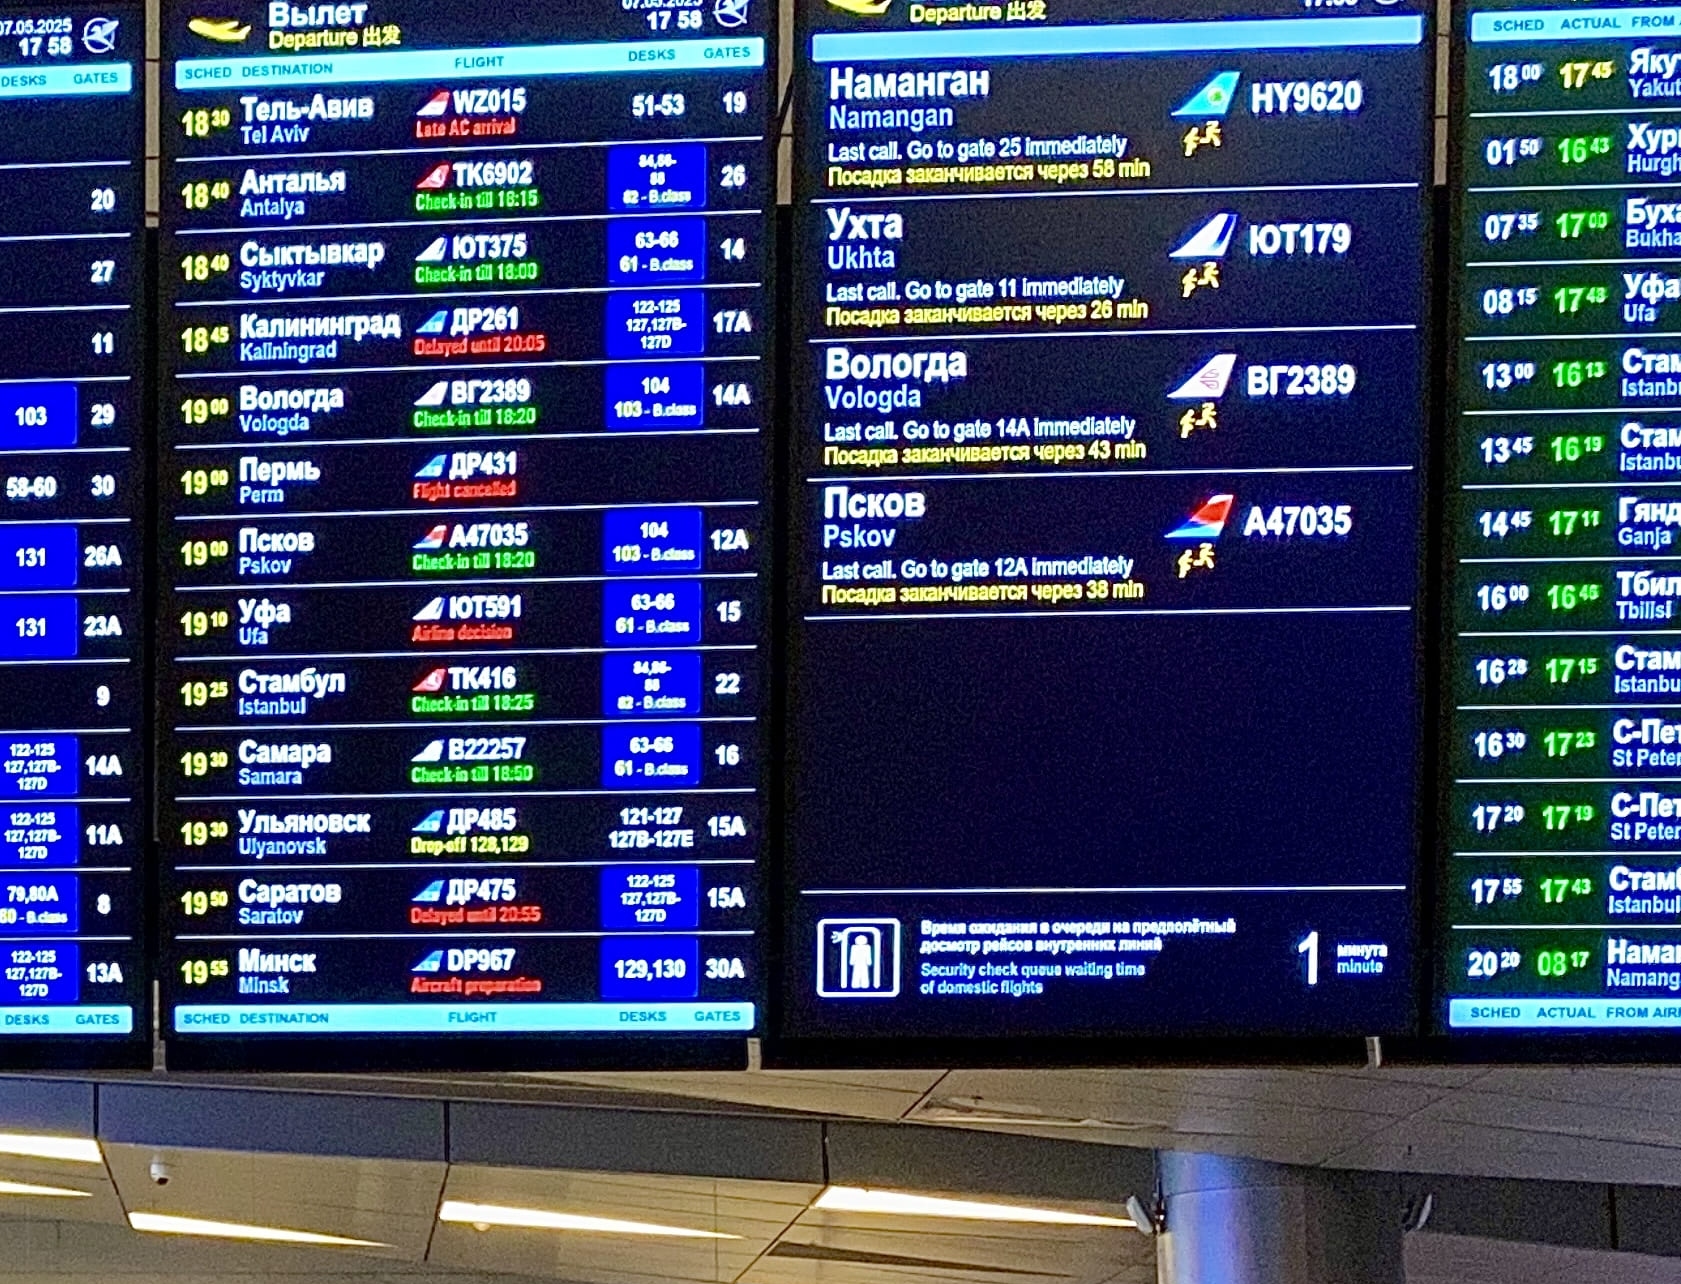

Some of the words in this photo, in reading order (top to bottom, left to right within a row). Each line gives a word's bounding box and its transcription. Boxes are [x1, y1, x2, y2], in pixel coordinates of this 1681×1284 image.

[269, 3, 367, 28] Вылет
[1494, 20, 1544, 32] SCHED
[1561, 18, 1620, 29] ACTUAL
[1632, 16, 1674, 28] FROM
[269, 29, 358, 49] Departure
[829, 69, 989, 100] Наманган
[241, 94, 374, 121] Тель-Авив
[454, 89, 526, 113] WZ015
[632, 95, 684, 116] 51-53
[723, 92, 746, 113] 19
[1251, 81, 1362, 112] HY9620
[829, 106, 953, 131] Namangan
[241, 126, 266, 144] Tel
[270, 125, 309, 143] Aviv
[828, 142, 865, 162] Last
[869, 140, 902, 160] call.
[907, 140, 932, 159] Go
[936, 139, 953, 158] to
[957, 140, 994, 161] gate
[999, 138, 1020, 157] 25
[1025, 135, 1126, 158] immediately
[828, 165, 902, 187] Посадка
[906, 162, 1033, 184] заканчивается
[1038, 160, 1087, 181] через
[1092, 160, 1114, 178] 58
[1118, 159, 1150, 177] min
[827, 209, 903, 240] Ухта
[452, 235, 527, 259] ЮТ375
[722, 239, 744, 259] 14
[1249, 224, 1351, 255] ЮТ179
[241, 241, 384, 269] Сыктывкар
[241, 270, 325, 290] Syktyvkar
[1623, 273, 1679, 299] Уфа
[1623, 304, 1655, 322] Ufa
[241, 313, 401, 340] Калининград
[92, 333, 114, 353] 11
[241, 341, 336, 361] Kaliningrad
[241, 386, 344, 412] Вологда
[452, 381, 530, 405] ВГ2389
[15, 408, 47, 425] 103
[92, 406, 114, 424] 29
[240, 458, 320, 485] Пермь
[240, 486, 284, 504] Perm
[823, 488, 925, 518] Псков
[823, 525, 894, 549] Pskov
[1619, 529, 1671, 546] Ganja
[1617, 602, 1672, 619] Tbilisi
[239, 741, 331, 765] Самара
[239, 767, 302, 785] Samara
[239, 810, 370, 834] Ульяновск
[239, 836, 326, 855] Ulyanovsk
[239, 950, 316, 974] Минск
[447, 950, 515, 971] DP967
[706, 959, 744, 979] 30A
[1298, 931, 1318, 985] 1
[1338, 960, 1382, 973] minute
[921, 963, 976, 979] Security
[979, 962, 1018, 975] check
[1022, 965, 1062, 980] queue
[1065, 962, 1112, 979] waiting
[1116, 962, 1145, 975] time
[239, 977, 289, 994] Minsk
[921, 981, 935, 994] of
[938, 981, 999, 994] domestic
[1002, 980, 1043, 996] flights
